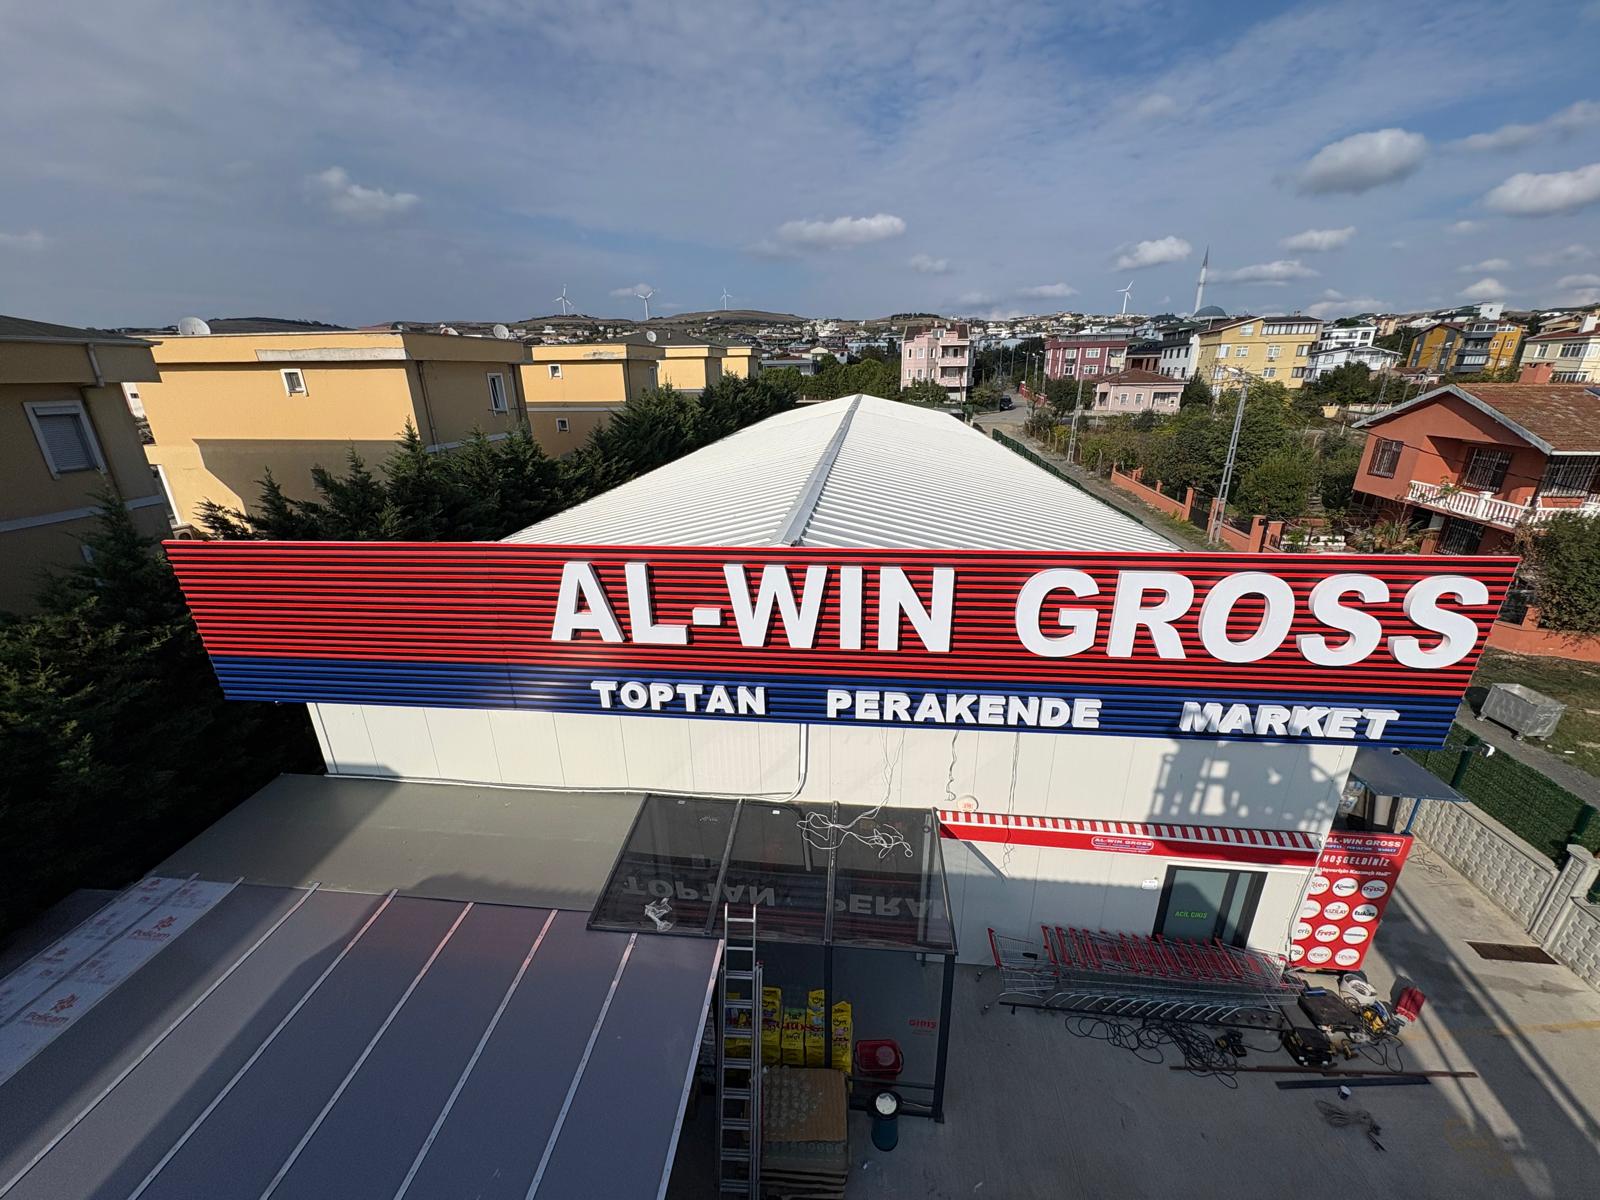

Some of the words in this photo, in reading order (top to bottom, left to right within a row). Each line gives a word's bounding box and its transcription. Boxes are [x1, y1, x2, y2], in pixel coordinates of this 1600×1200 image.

[551, 562, 955, 653] AL-WIN
[1015, 568, 1489, 669] GROSS
[590, 680, 766, 715] TOPTAN
[826, 689, 1102, 729] PERAKENDE
[1179, 701, 1400, 740] MARKET
[1365, 839, 1401, 848] GROSS
